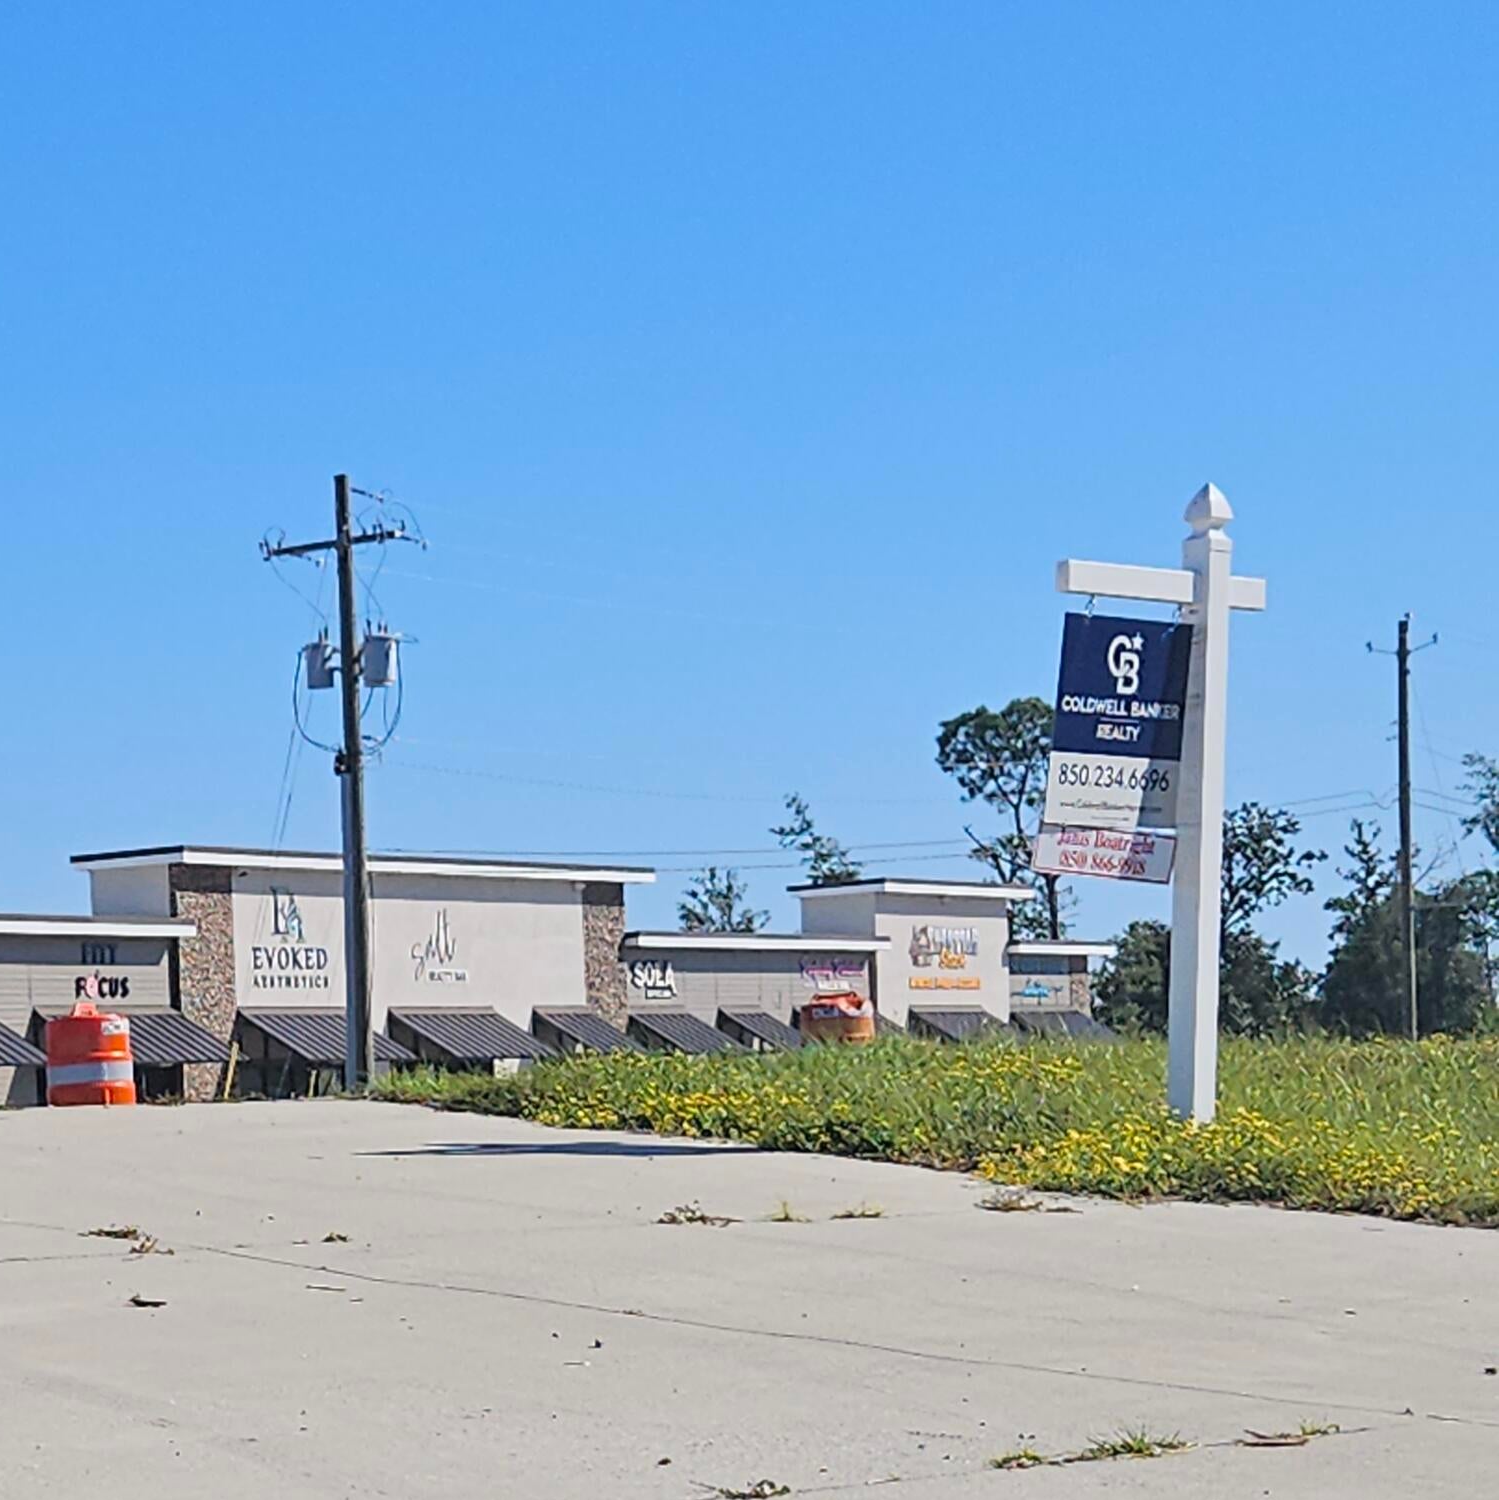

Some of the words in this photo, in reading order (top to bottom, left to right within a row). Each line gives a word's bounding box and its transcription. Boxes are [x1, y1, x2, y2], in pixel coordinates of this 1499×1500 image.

[1061, 695, 1128, 716] COLDWELL
[1130, 702, 1180, 719] BANKER
[1096, 724, 1140, 742] REALTY
[1058, 763, 1169, 792] 850.234.6696
[252, 946, 329, 970] EVOKED
